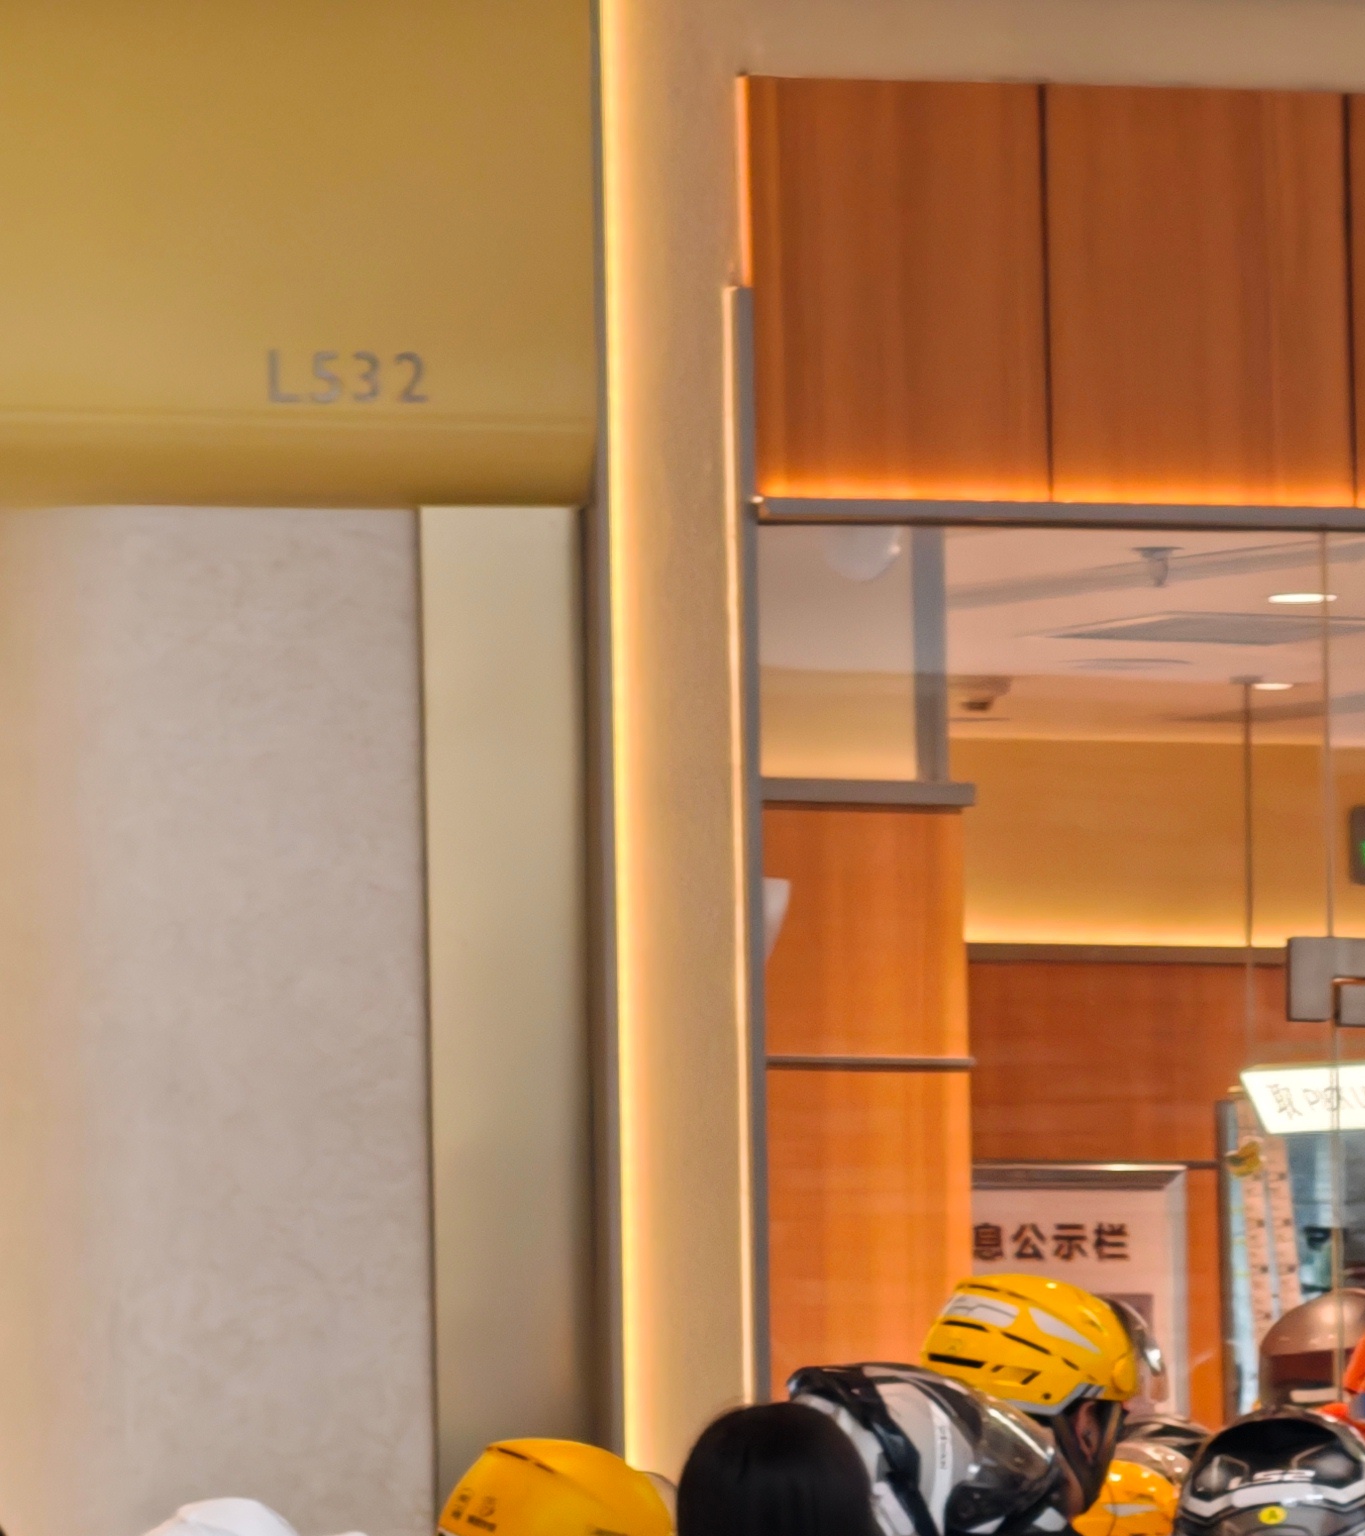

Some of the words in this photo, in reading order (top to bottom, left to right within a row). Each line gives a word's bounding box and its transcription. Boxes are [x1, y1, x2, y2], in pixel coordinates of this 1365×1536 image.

[266, 349, 429, 405] L532
[973, 1222, 1131, 1261] 息公示栏
